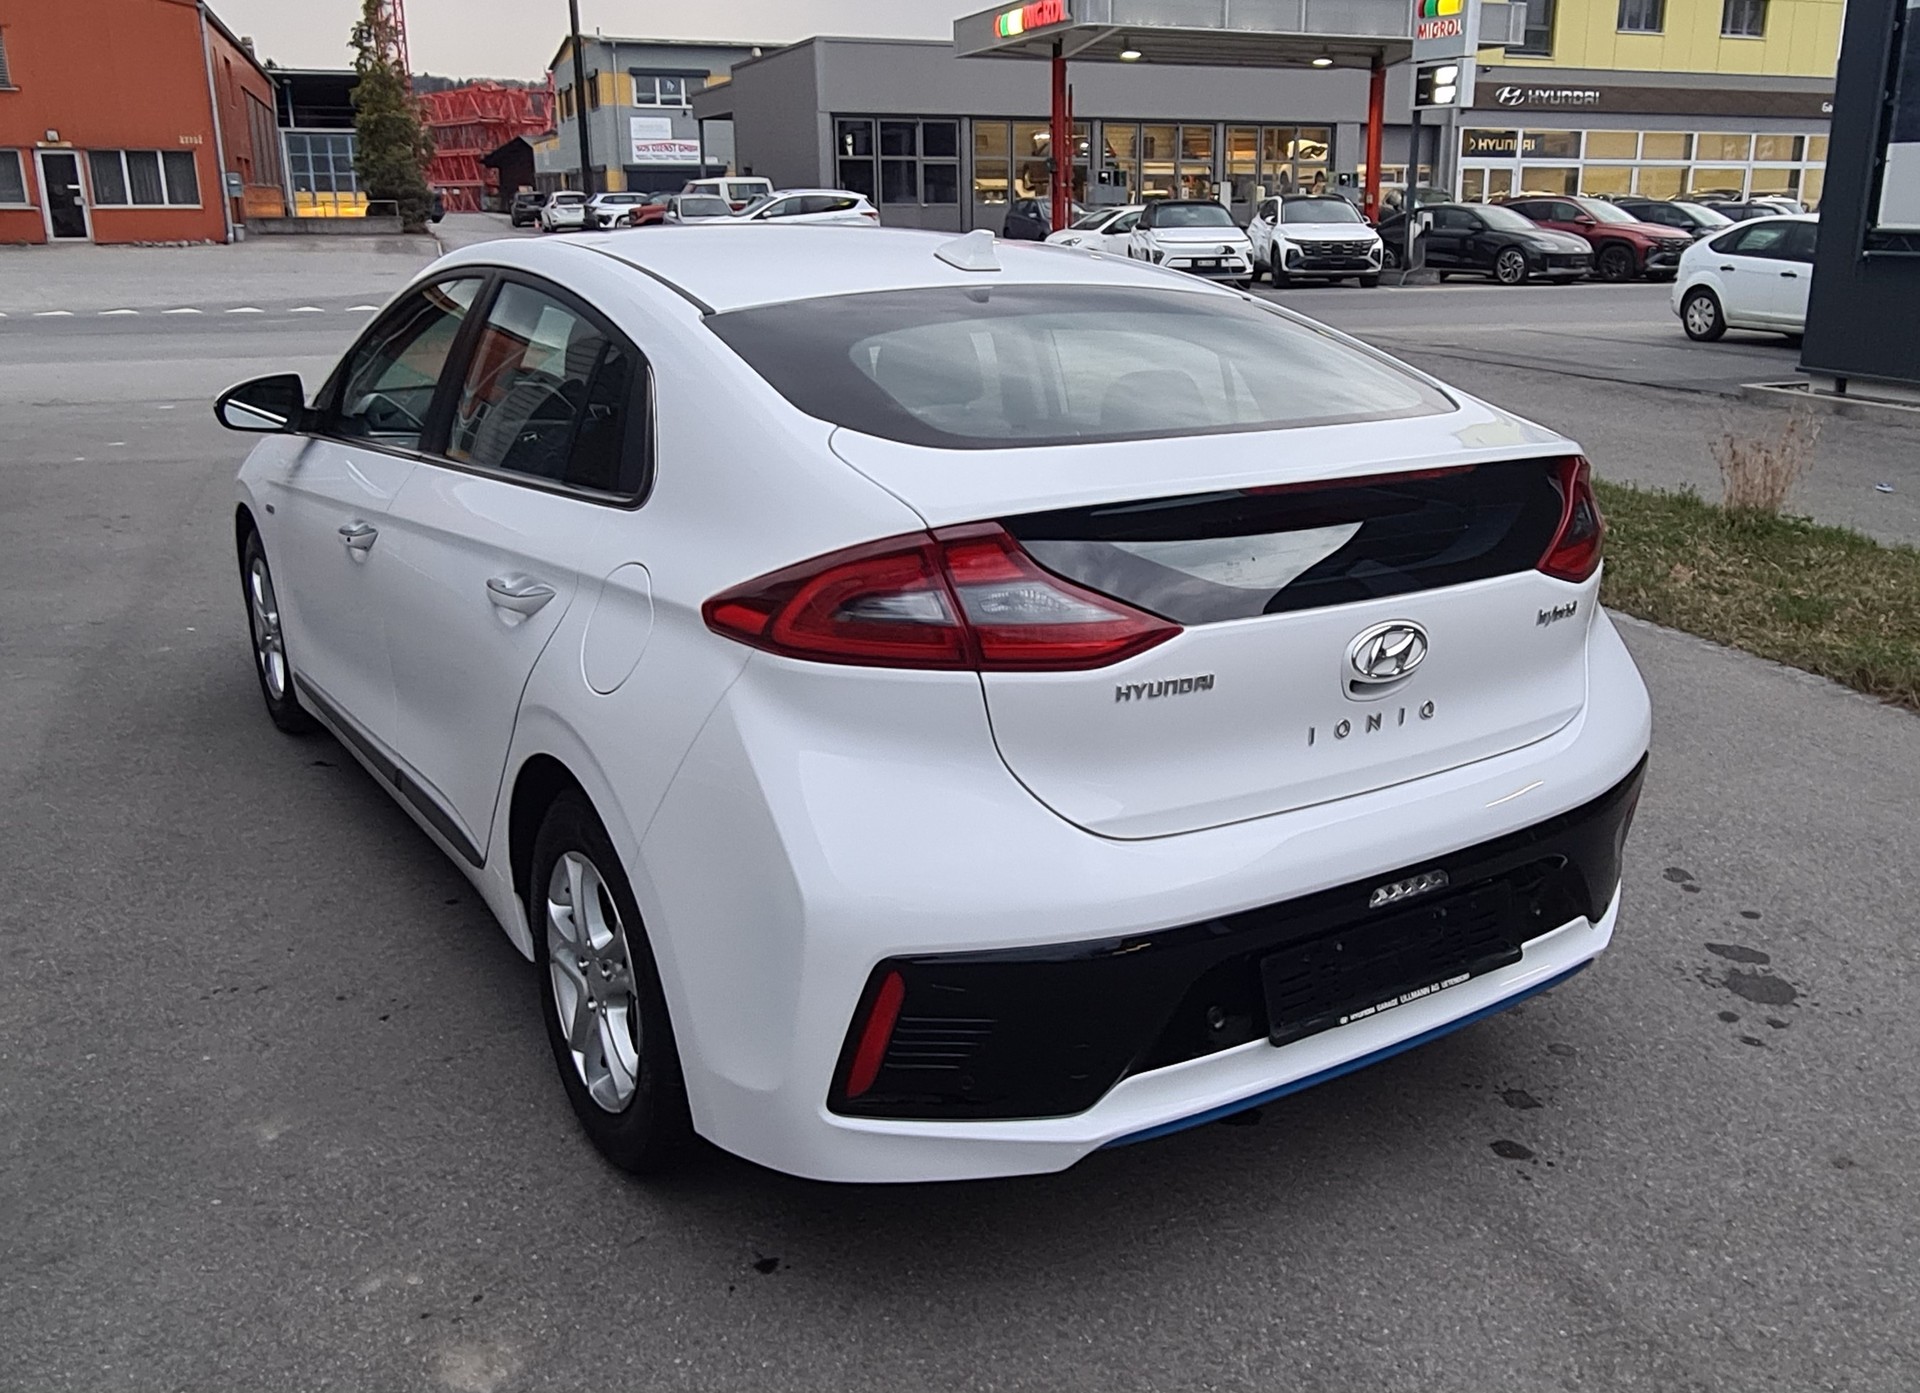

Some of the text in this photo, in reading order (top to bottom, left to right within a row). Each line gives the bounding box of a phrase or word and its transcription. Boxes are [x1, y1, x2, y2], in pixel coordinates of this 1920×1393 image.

[1023, 0, 1066, 30] MIGROL
[1417, 18, 1463, 39] MIGROL
[1528, 90, 1600, 105] HYUNDAI
[1478, 138, 1536, 151] HYUNAI
[1115, 674, 1215, 702] HYUNDAI
[1308, 700, 1434, 746] IONIQ
